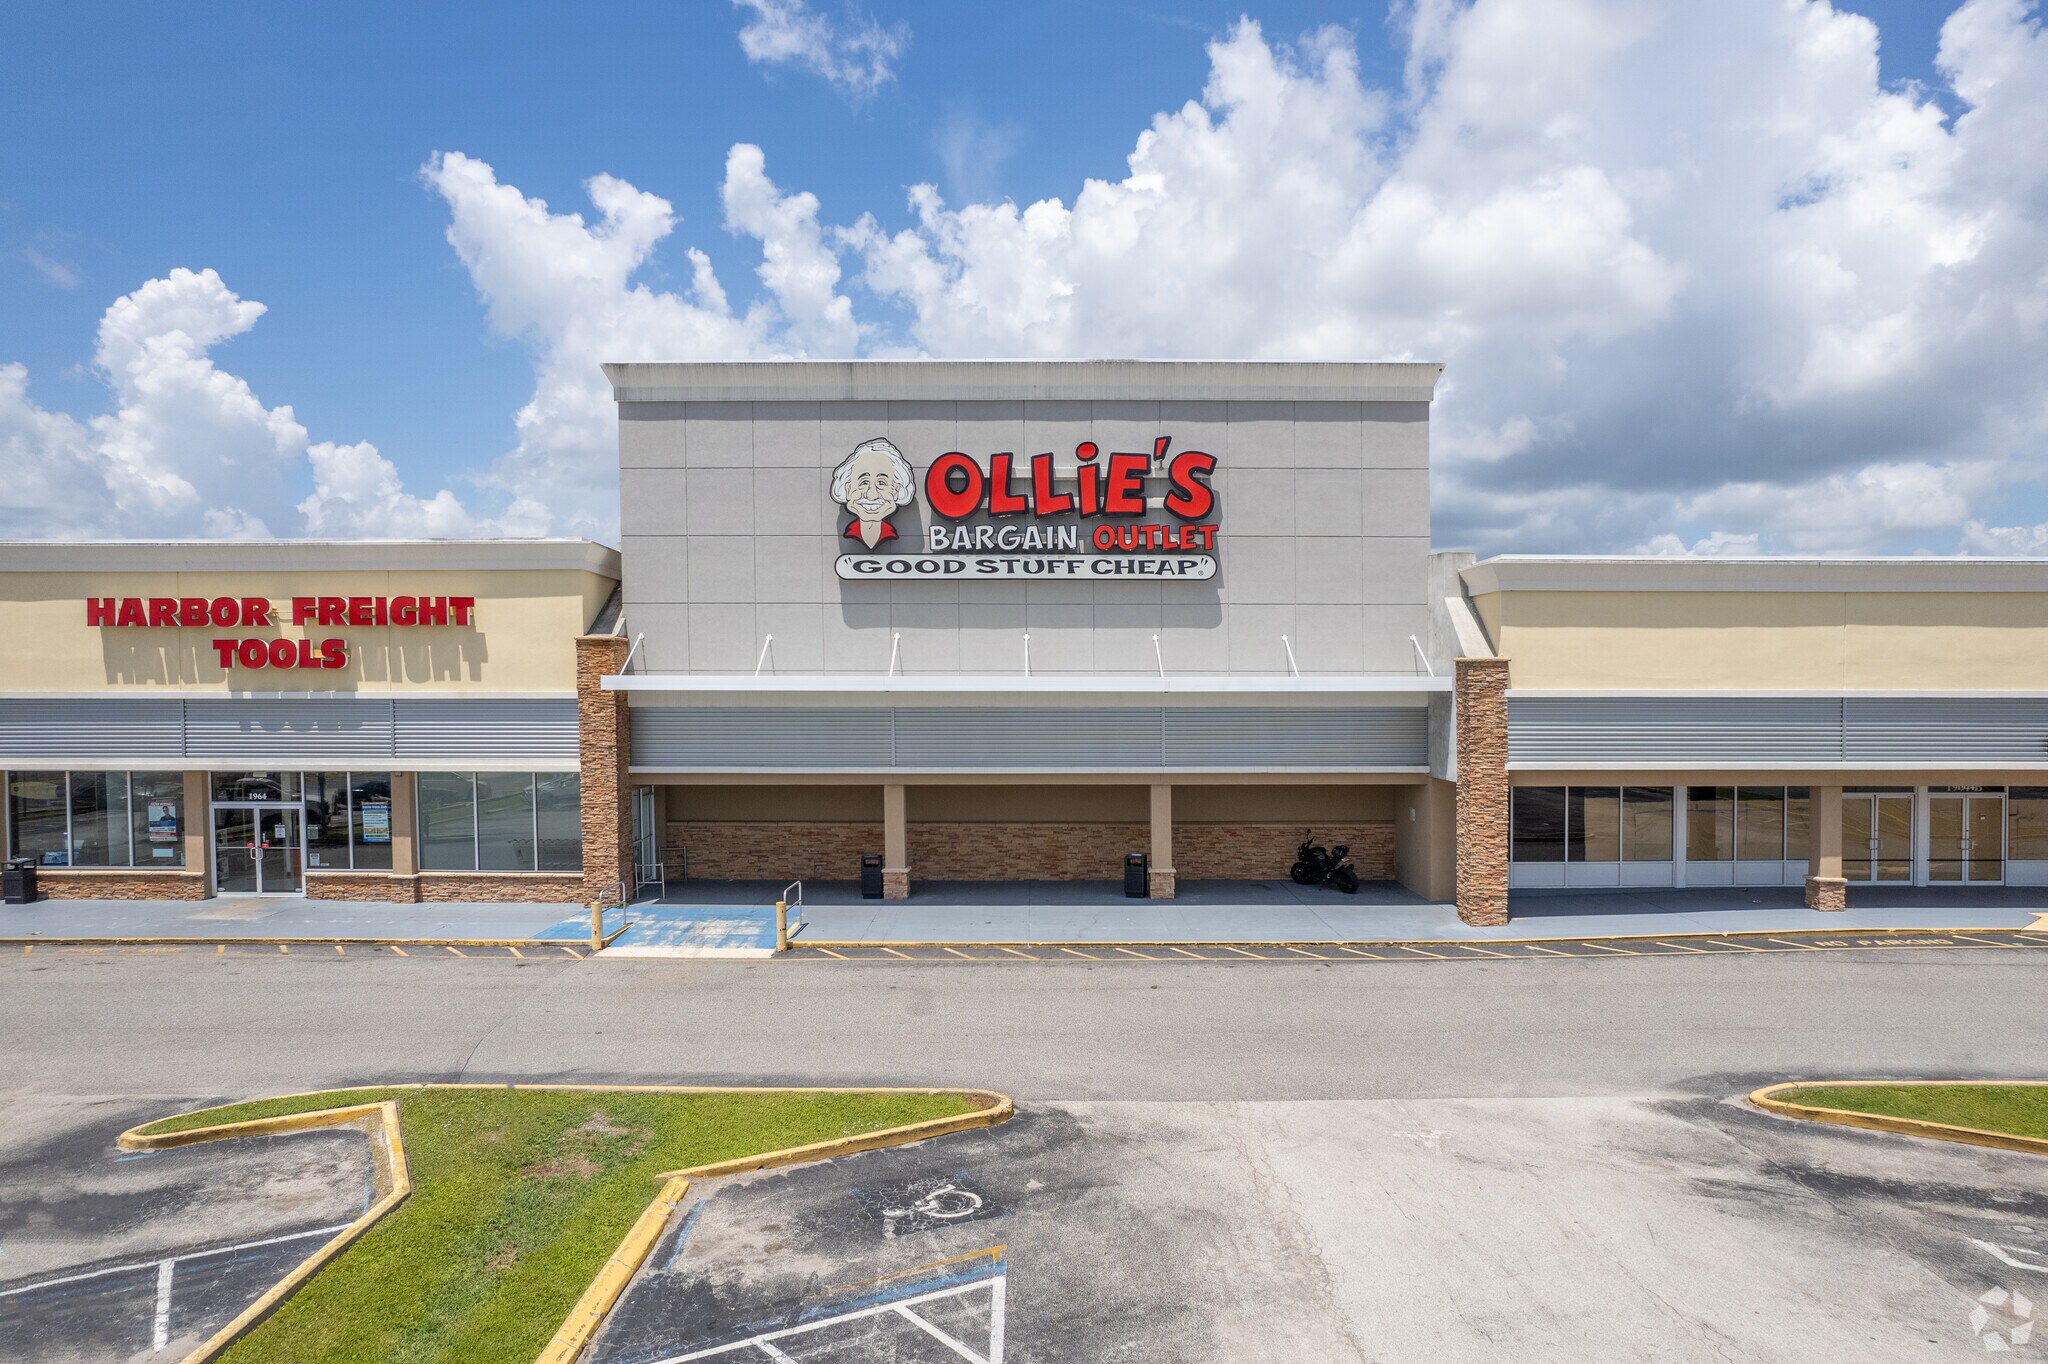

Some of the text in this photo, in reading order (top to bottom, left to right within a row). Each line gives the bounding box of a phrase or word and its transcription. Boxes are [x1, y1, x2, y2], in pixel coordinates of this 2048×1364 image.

[929, 524, 1220, 552] BARGAIN OUTLET
[844, 557, 967, 574] "GOOD
[975, 558, 1086, 575] STUFF
[87, 596, 476, 628] HARBOR FREIGHT
[212, 638, 348, 670] TOOLS
[248, 792, 268, 800] 1964
[1856, 938, 1954, 946] PARKING
